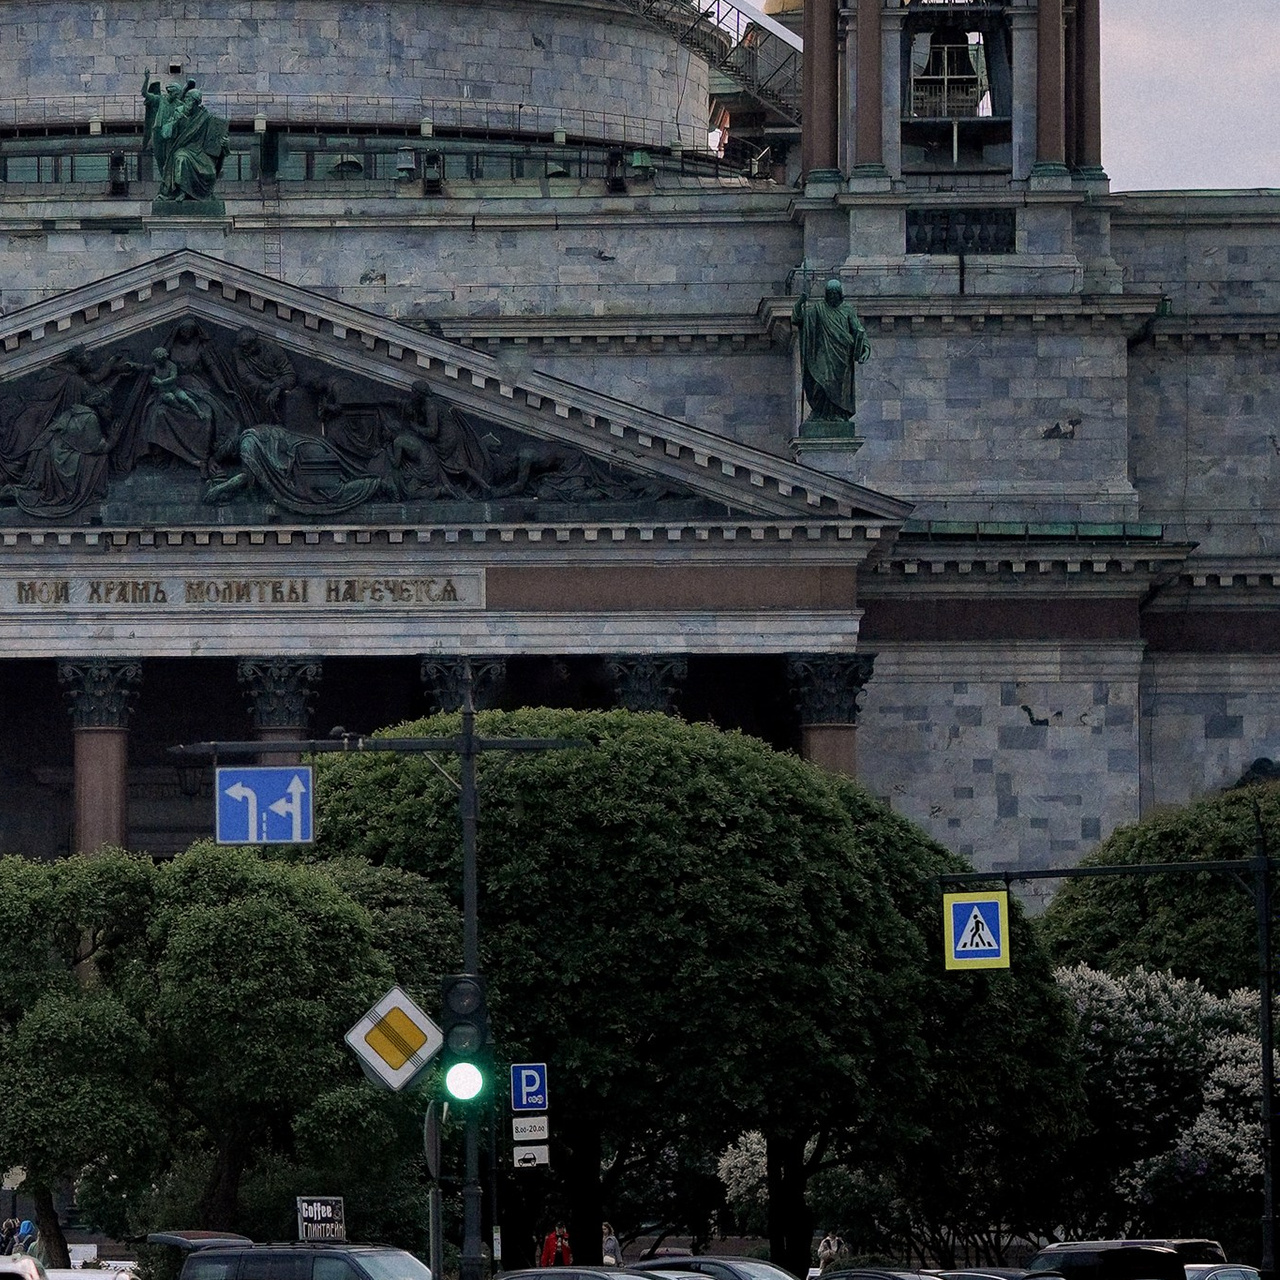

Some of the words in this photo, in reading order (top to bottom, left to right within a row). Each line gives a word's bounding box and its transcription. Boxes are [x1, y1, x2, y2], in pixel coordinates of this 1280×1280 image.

[88, 581, 167, 604] ХРАМЪ
[521, 1069, 540, 1105] P
[302, 1202, 333, 1221] Coffee
